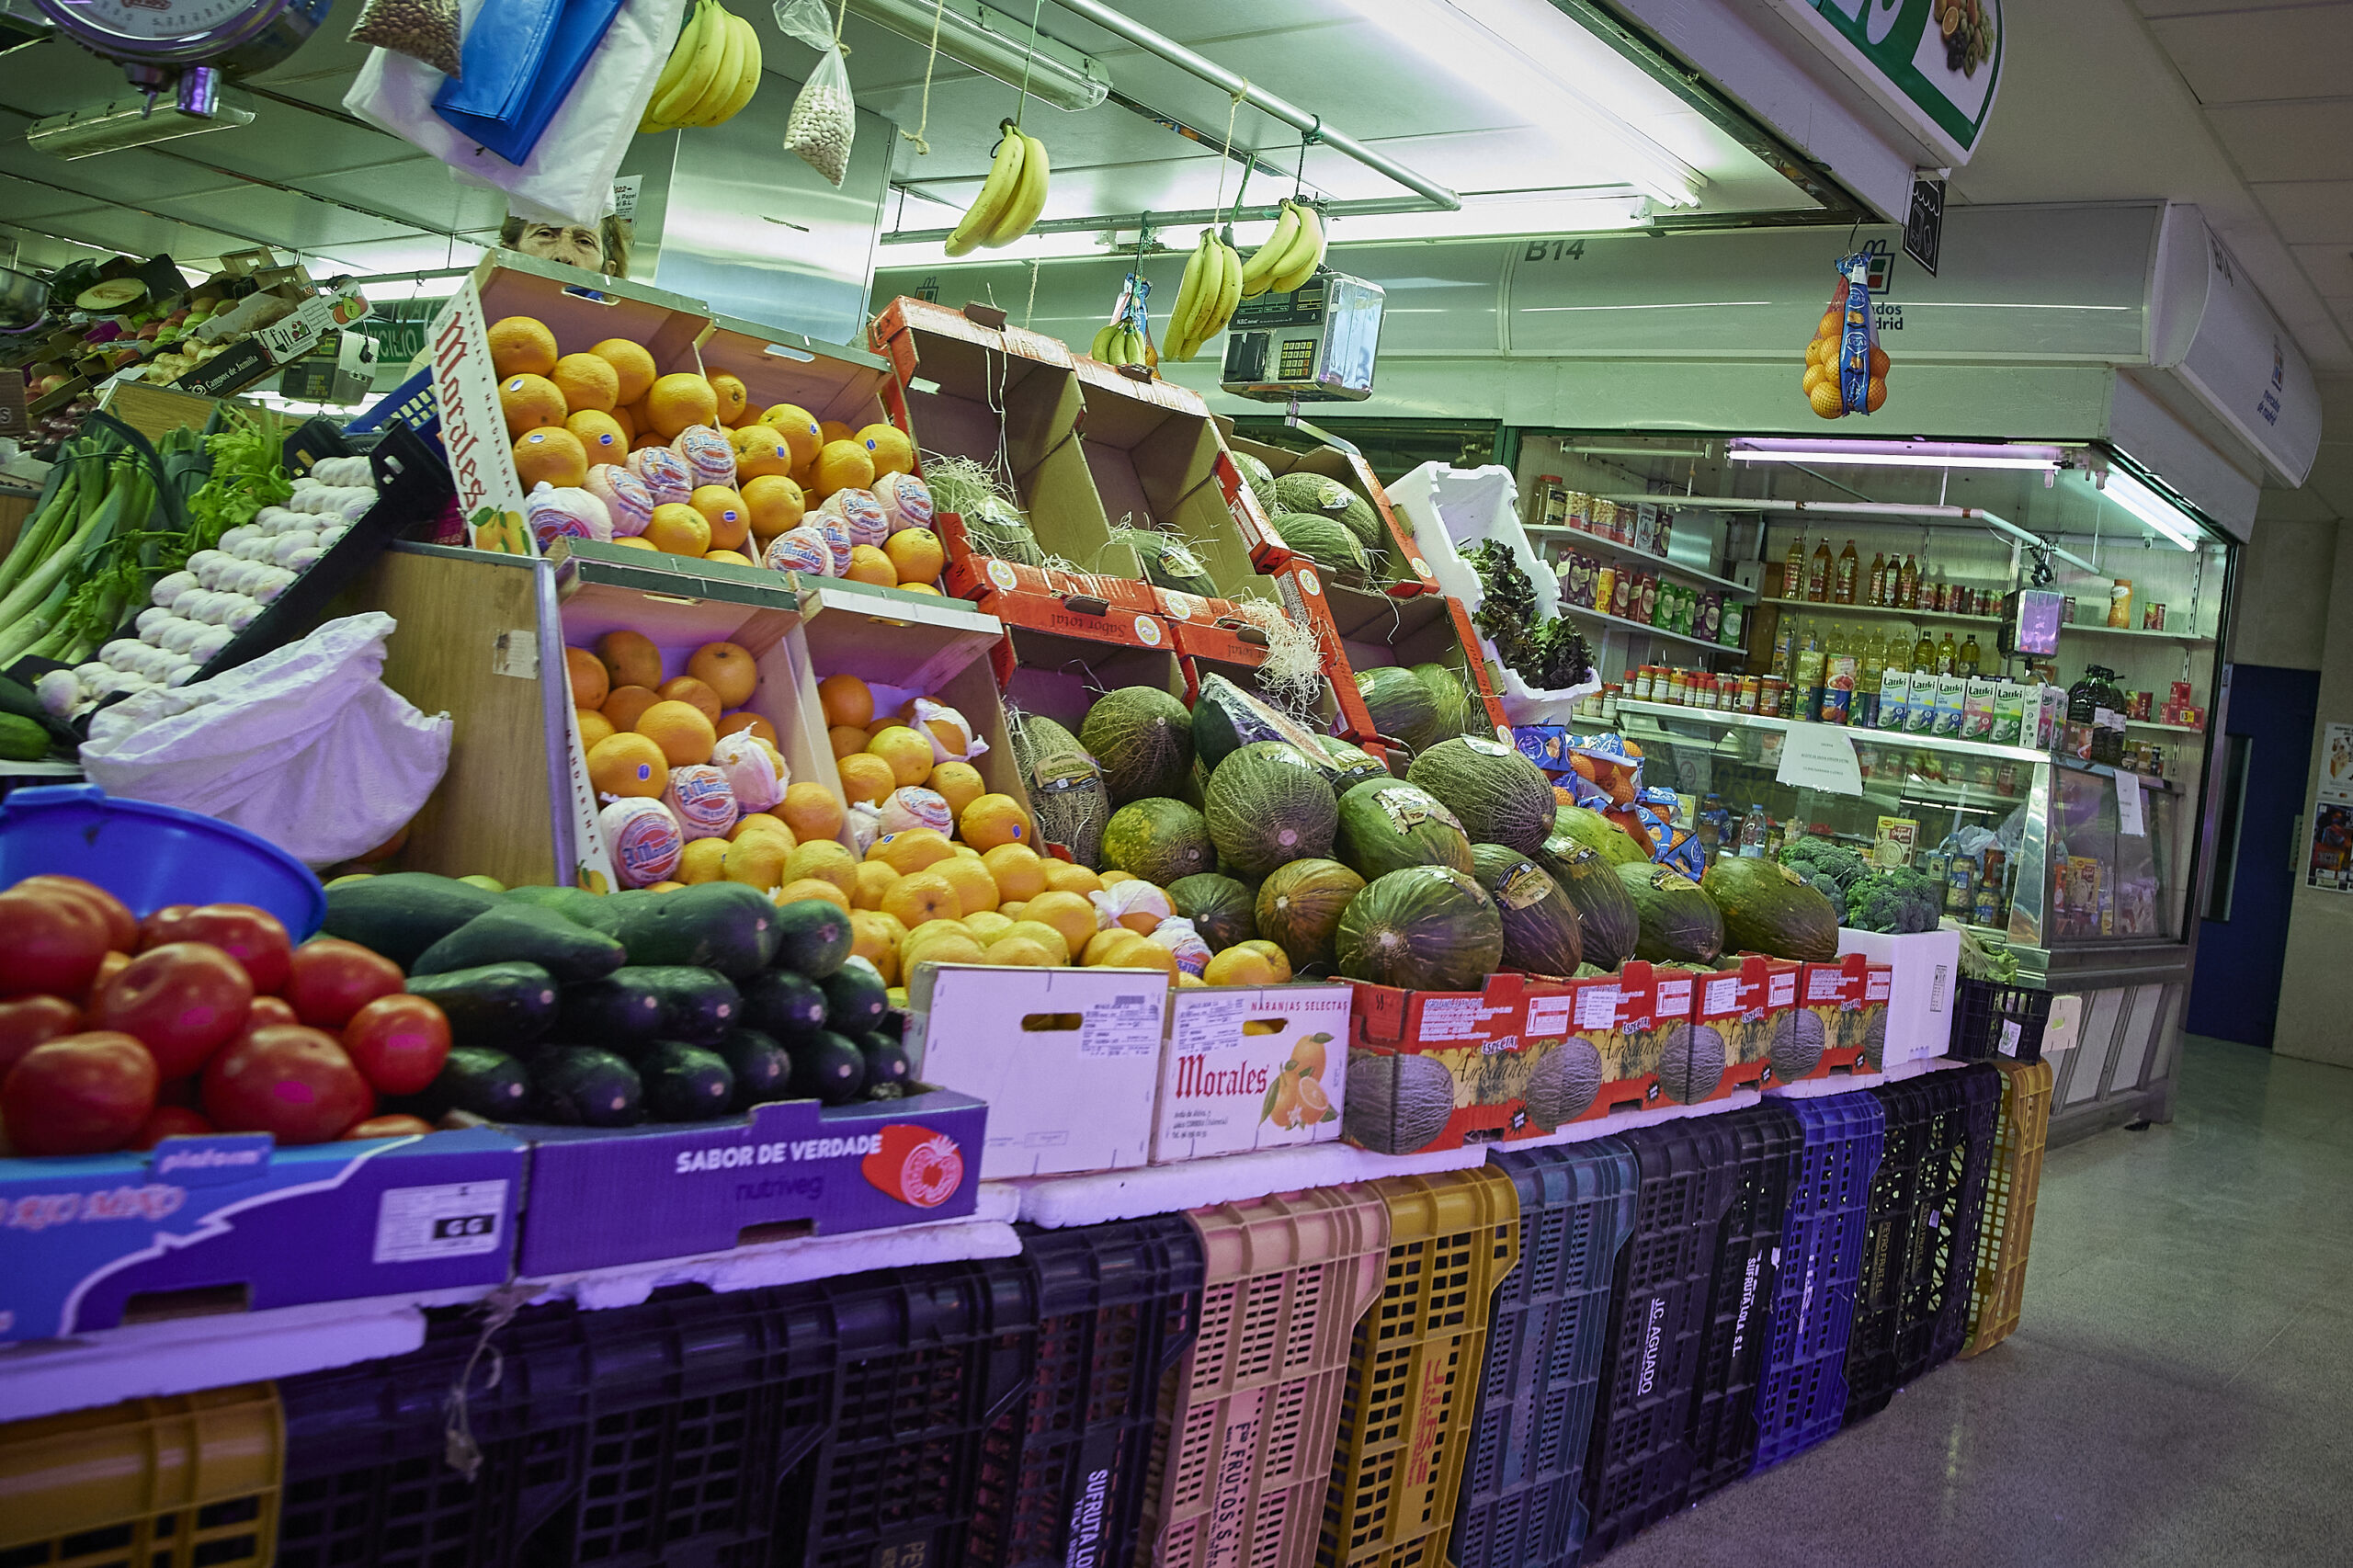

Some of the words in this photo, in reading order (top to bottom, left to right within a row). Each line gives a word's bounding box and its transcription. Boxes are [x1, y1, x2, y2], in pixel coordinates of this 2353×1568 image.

[1525, 240, 1585, 261] B14
[1879, 318, 1904, 330] drid
[1051, 613, 1084, 630] total
[1087, 616, 1127, 638] Sabor
[1883, 676, 1907, 688] Lauki
[1913, 679, 1936, 691] Lauki
[1939, 683, 1963, 694] Lauki
[1969, 686, 1993, 697] Lauki
[1998, 688, 2022, 700] Lauki
[1251, 1000, 1302, 1012] NARANJAS
[1305, 999, 1348, 1012] SELECTAS
[1176, 1053, 1269, 1099] Morales
[675, 1145, 756, 1174] SABOR
[756, 1142, 788, 1165] DE
[790, 1133, 883, 1162] VERDADE
[1641, 1325, 1661, 1394] AGUADO
[1084, 1469, 1108, 1539] SUFRUTA
